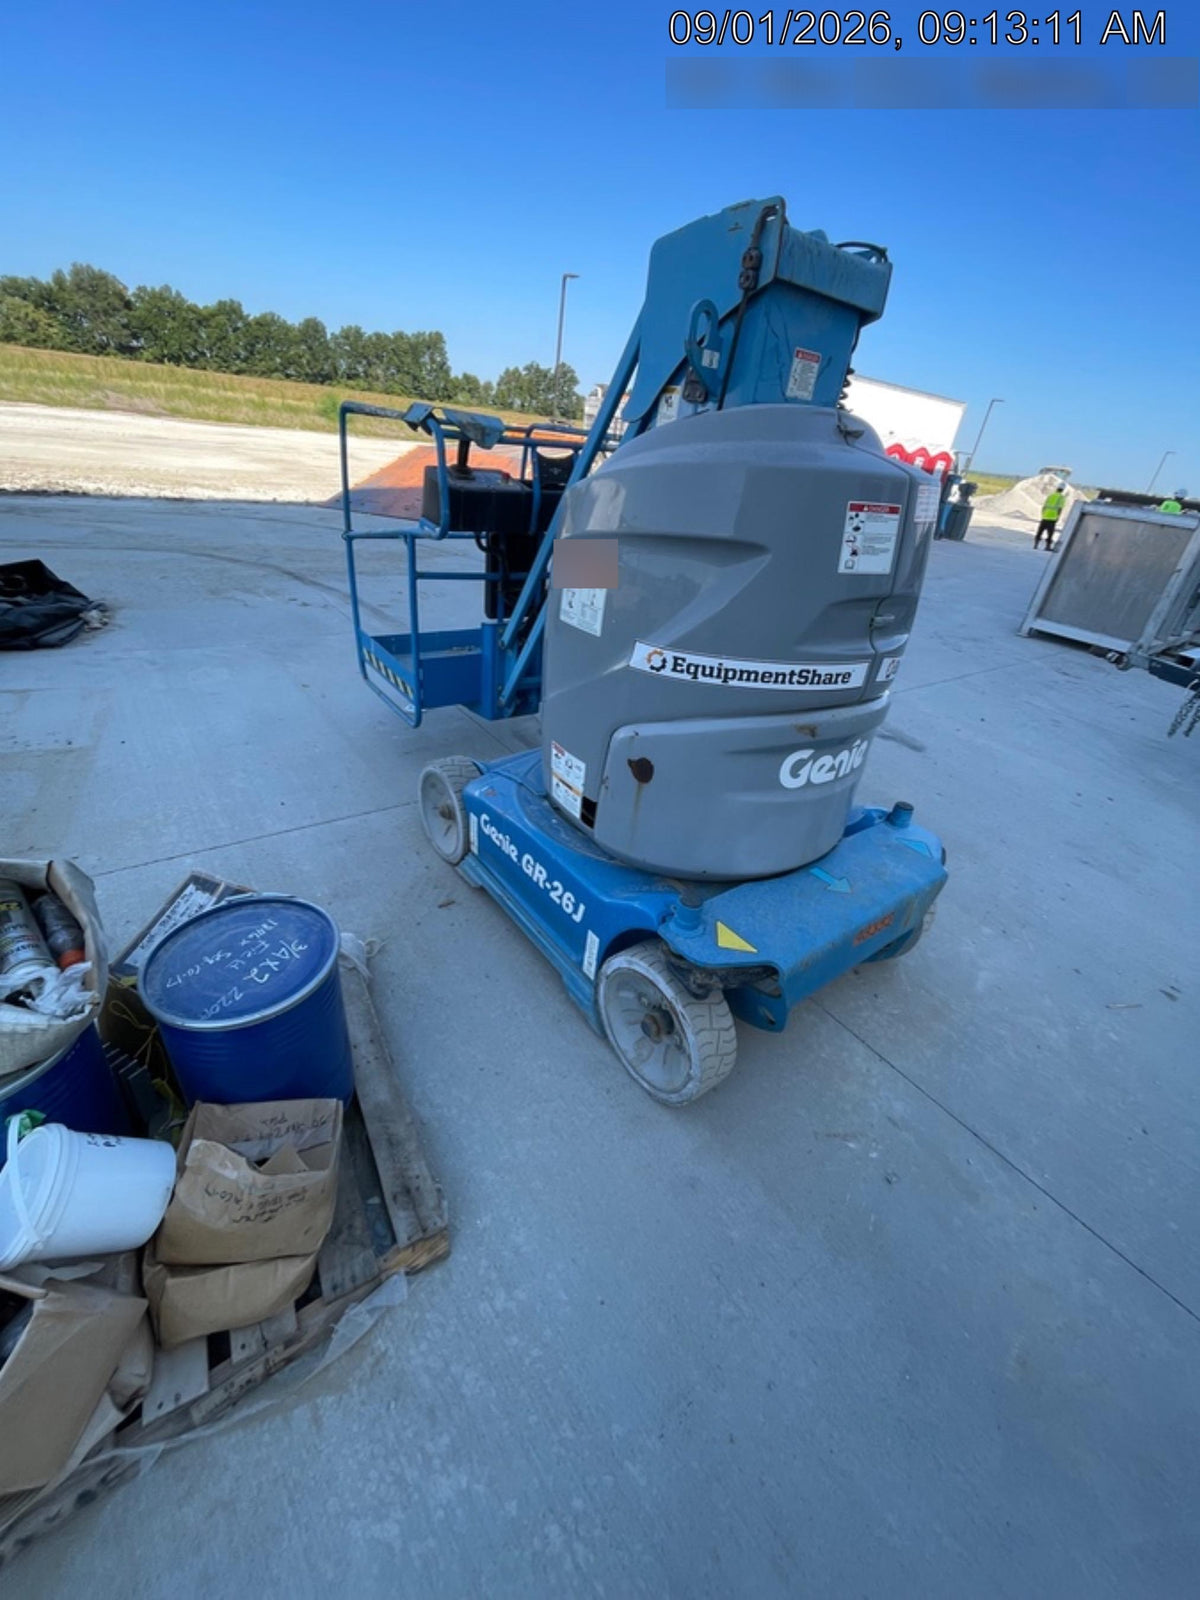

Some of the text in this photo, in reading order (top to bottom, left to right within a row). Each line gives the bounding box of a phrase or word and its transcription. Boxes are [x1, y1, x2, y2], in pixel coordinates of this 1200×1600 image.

[670, 655, 852, 686] EquipmentShare
[779, 739, 869, 789] Genie
[479, 813, 519, 863] Genie
[521, 853, 586, 923] GR-26J
